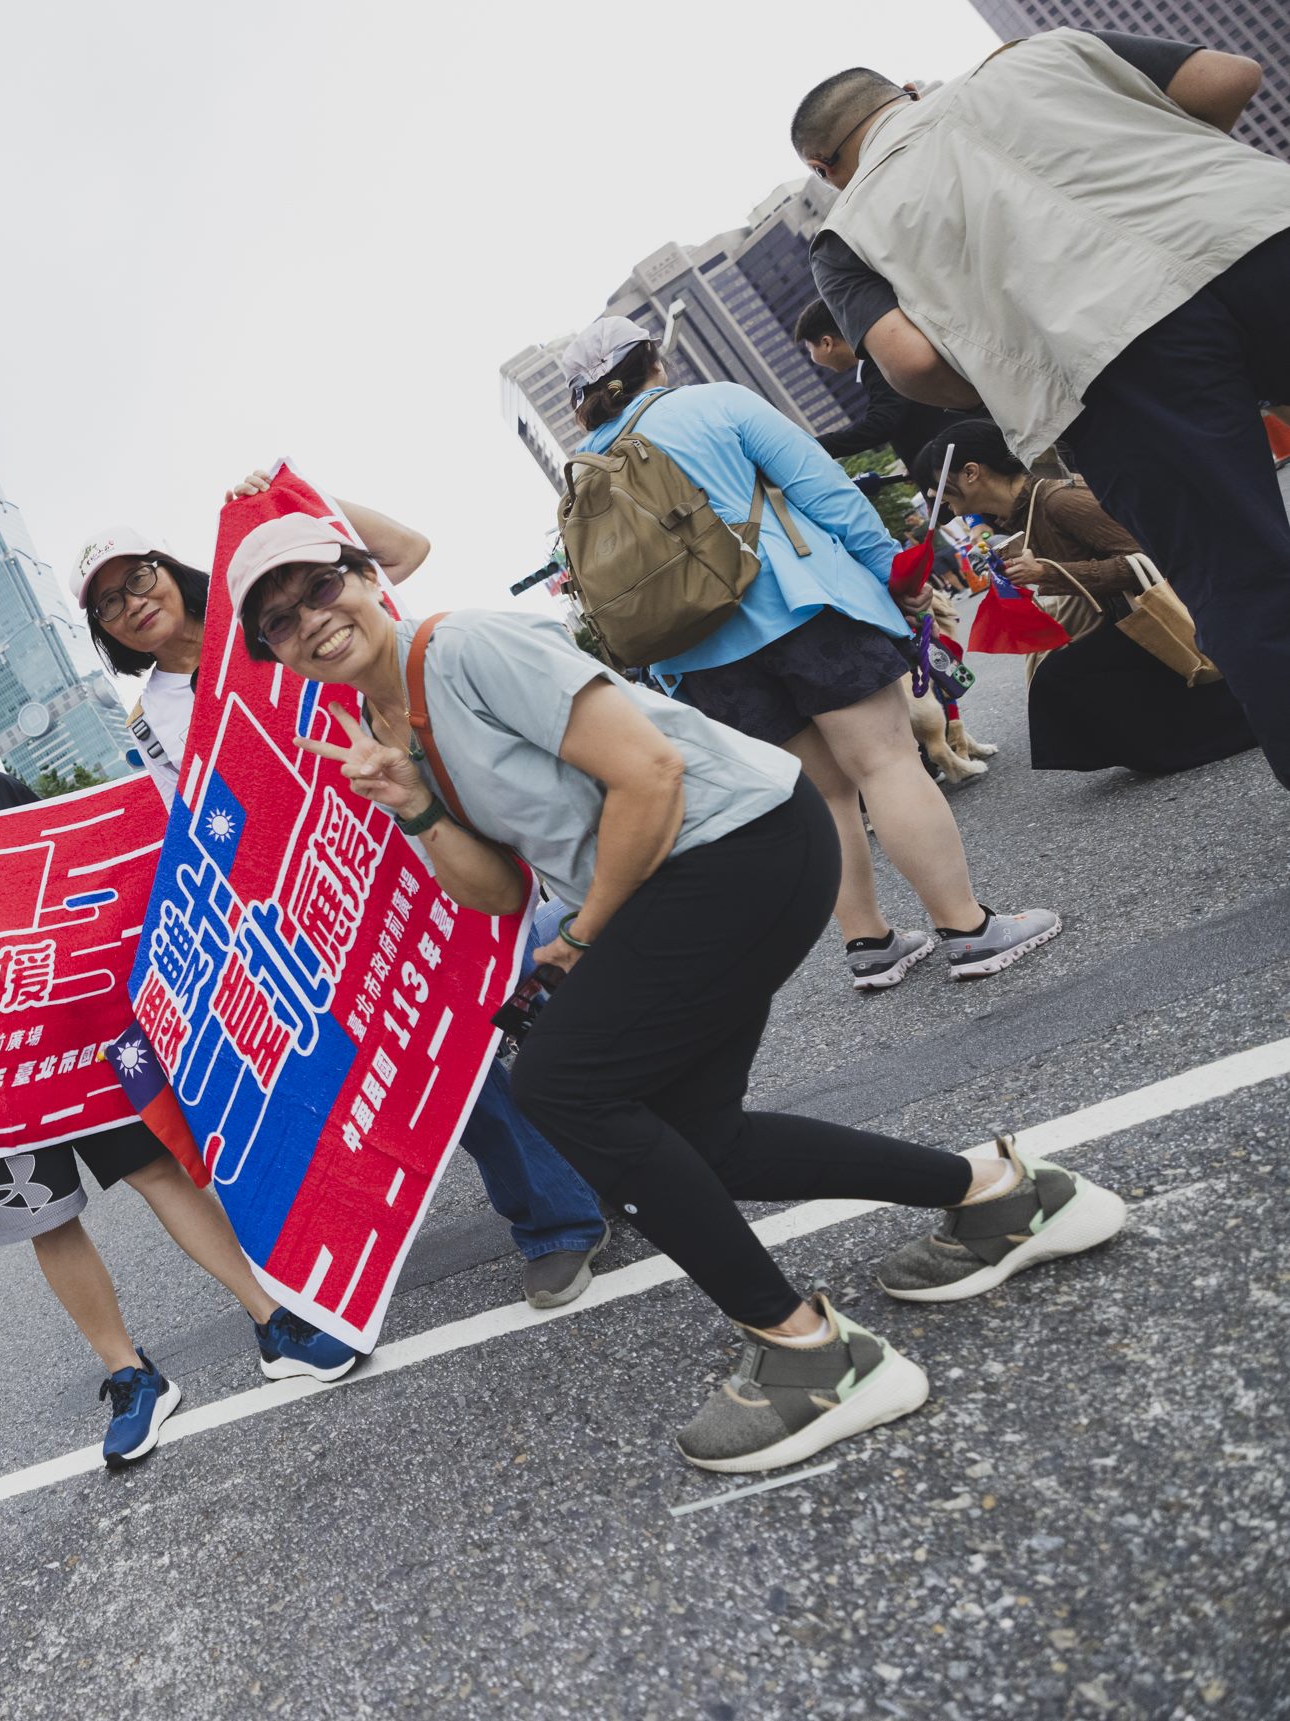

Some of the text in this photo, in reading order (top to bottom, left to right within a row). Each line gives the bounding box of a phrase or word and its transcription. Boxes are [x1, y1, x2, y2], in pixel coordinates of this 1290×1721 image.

[133, 857, 233, 1084] 慶雙十
[209, 786, 383, 1095] 臺北應援
[341, 1046, 397, 1153] 中華民國
[383, 960, 429, 1051] 113
[417, 931, 442, 971] 年
[347, 866, 420, 1043] 臺北市政府前廣場
